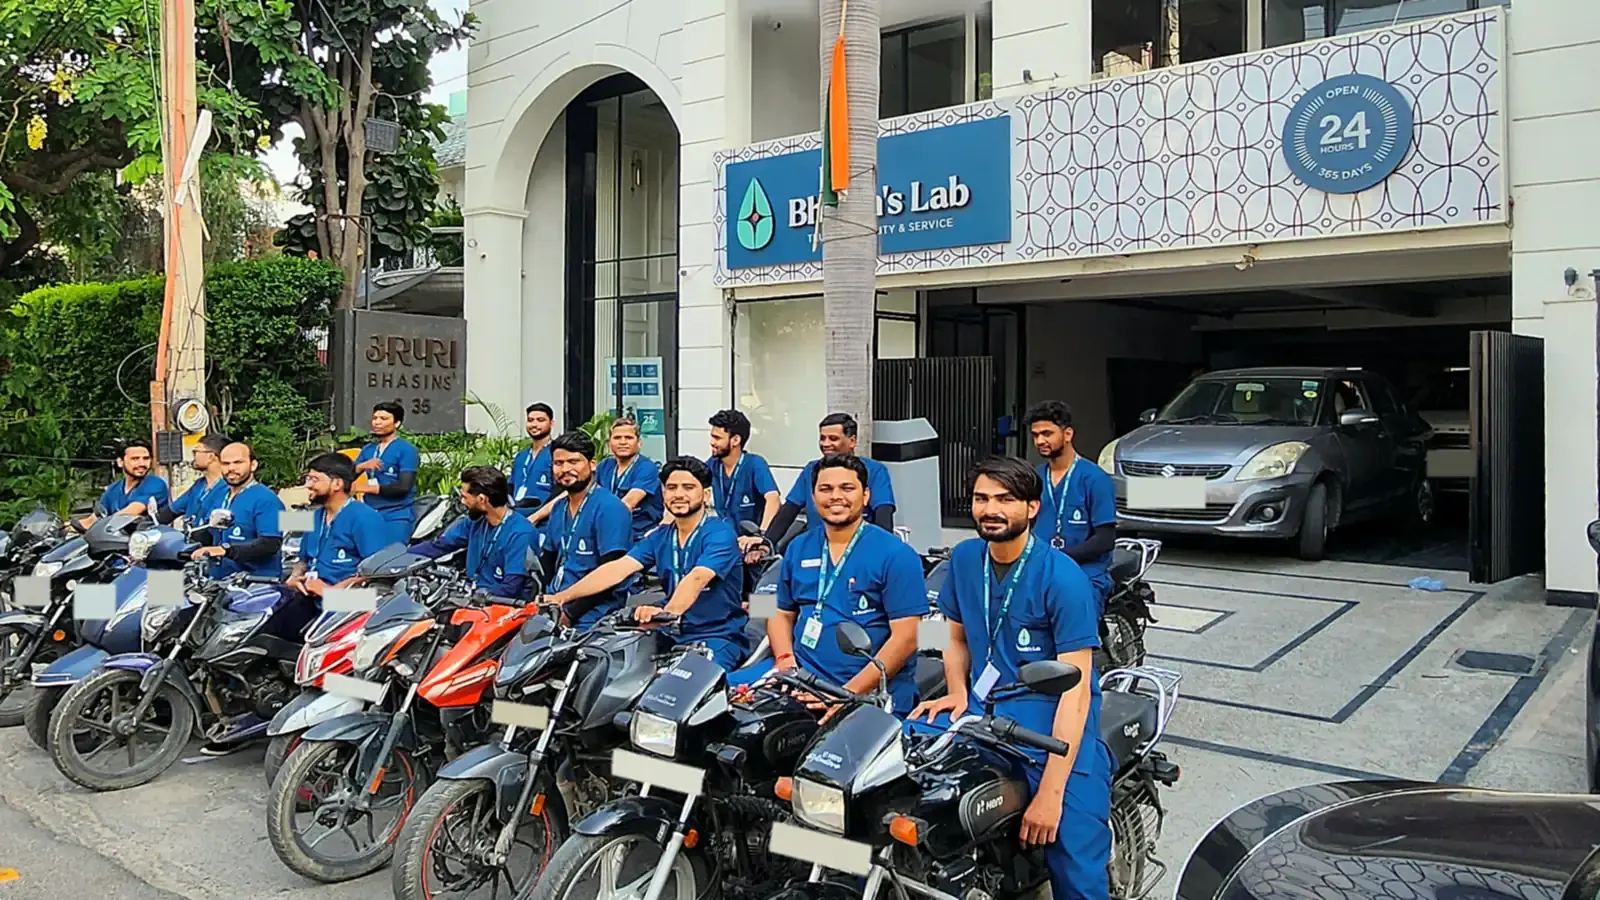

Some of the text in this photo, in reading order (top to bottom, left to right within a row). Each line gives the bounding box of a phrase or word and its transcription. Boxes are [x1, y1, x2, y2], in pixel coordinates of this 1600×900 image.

[1326, 85, 1360, 99] OPEN
[1319, 111, 1371, 149] 24
[1320, 142, 1354, 154] HOURS
[1318, 162, 1373, 180] 365 DAYS
[911, 175, 970, 212] Lab
[898, 223, 906, 233] &
[908, 217, 955, 232] SERVICE
[411, 399, 432, 415] 35
